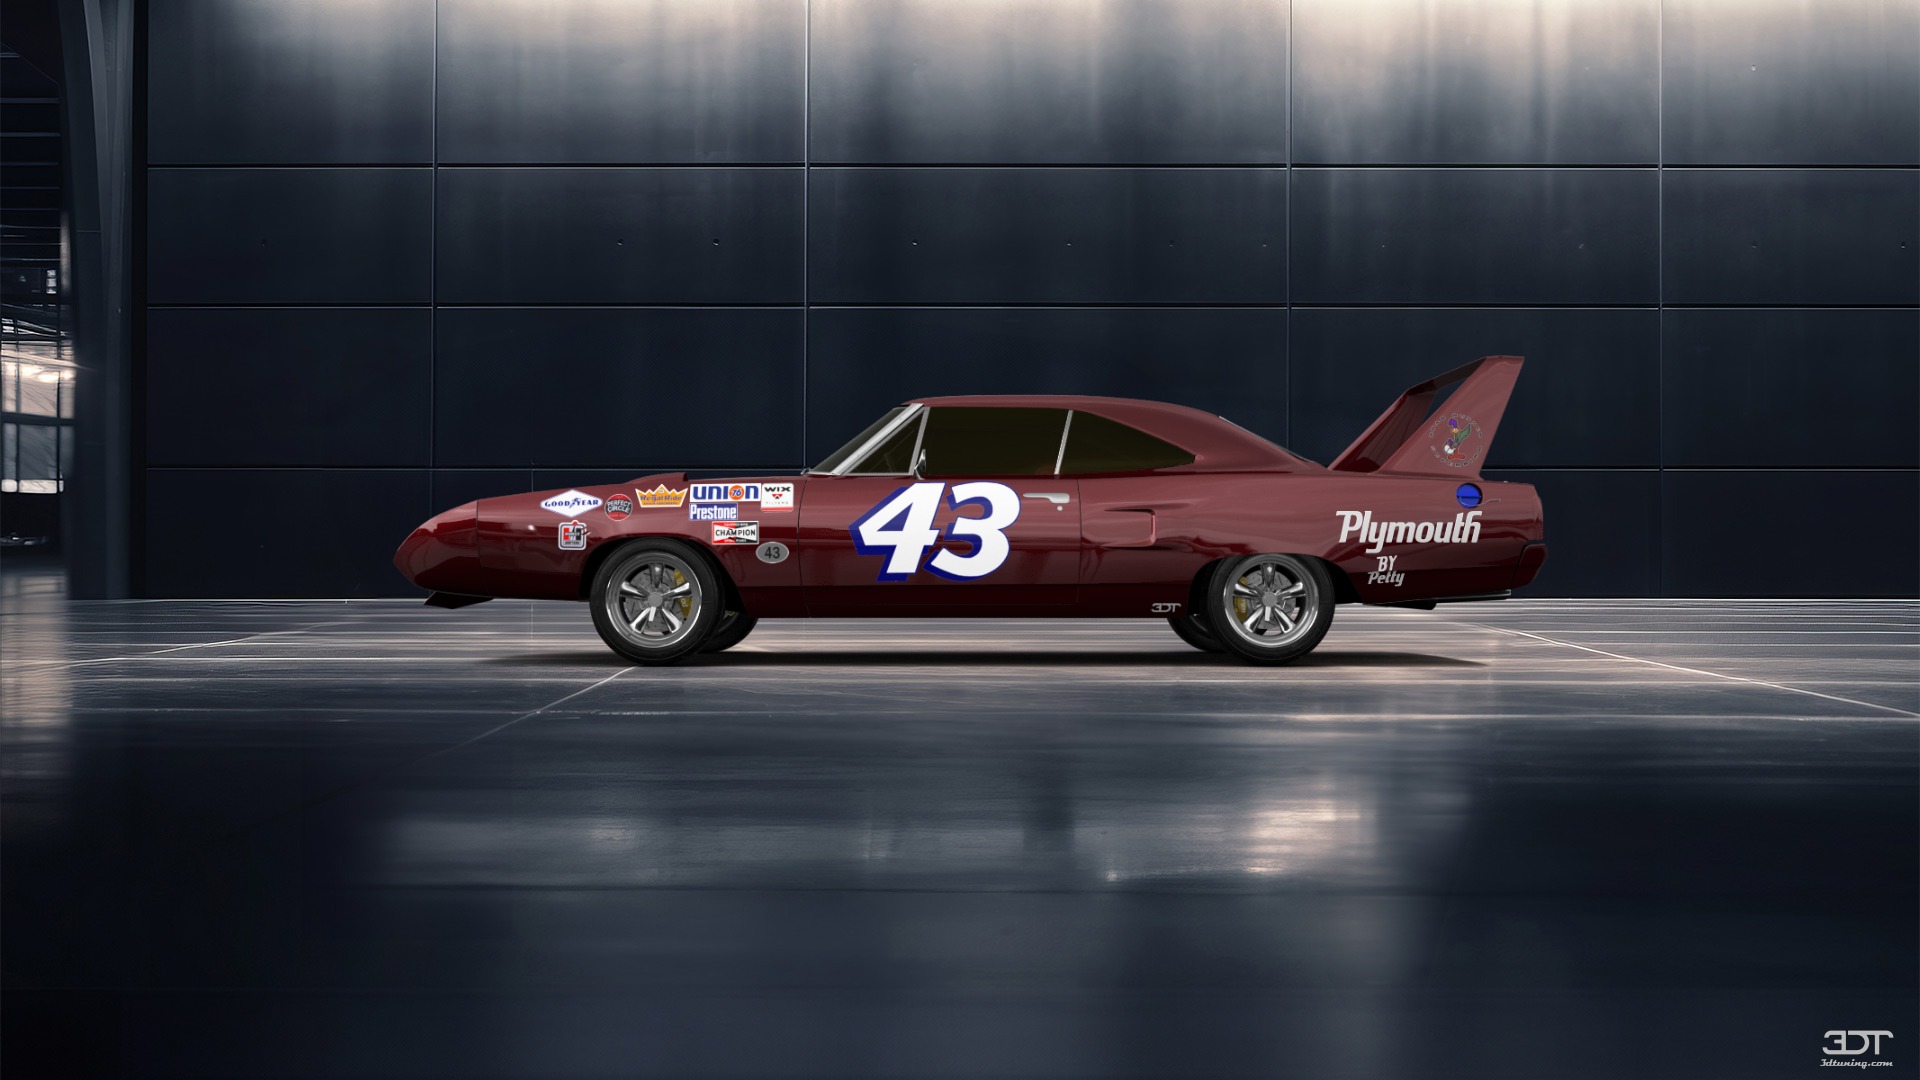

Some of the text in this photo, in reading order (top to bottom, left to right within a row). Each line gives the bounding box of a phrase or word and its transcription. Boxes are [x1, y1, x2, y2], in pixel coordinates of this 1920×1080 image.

[690, 504, 737, 520] Prestone
[715, 529, 756, 537] CHAMPION
[848, 481, 1022, 582] 43
[1335, 510, 1483, 554] Plymouth
[764, 546, 780, 559] 43
[1376, 555, 1398, 572] BY
[1367, 571, 1405, 587] Petty
[1151, 602, 1182, 613] 3DT
